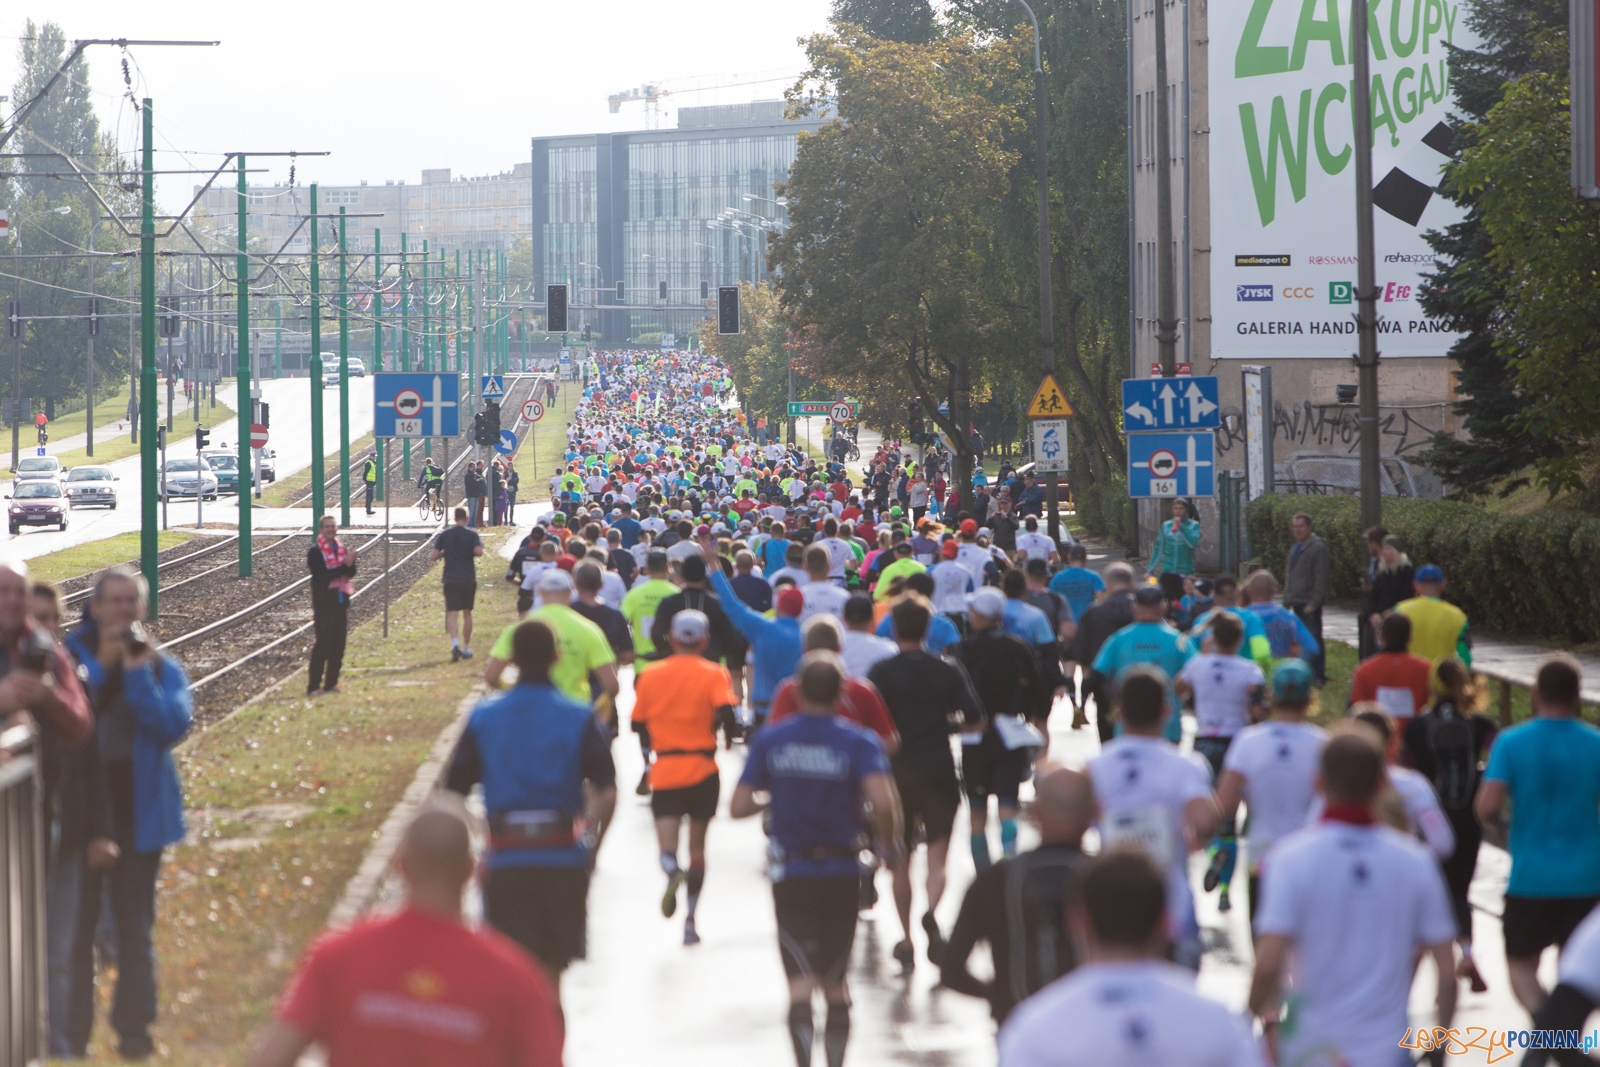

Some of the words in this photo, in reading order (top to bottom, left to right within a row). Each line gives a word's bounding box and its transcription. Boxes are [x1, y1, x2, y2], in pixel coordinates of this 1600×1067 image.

[1238, 59, 1451, 228] WCĄGAJ
[1237, 257, 1282, 265] mediaexpert
[1309, 256, 1359, 265] ROSSMAN
[1244, 288, 1272, 297] JYSK
[1282, 287, 1314, 299] CCC
[1236, 321, 1304, 335] GALERIA
[1310, 320, 1402, 335] HANDWA
[526, 405, 541, 416] 70
[834, 407, 848, 418] 70
